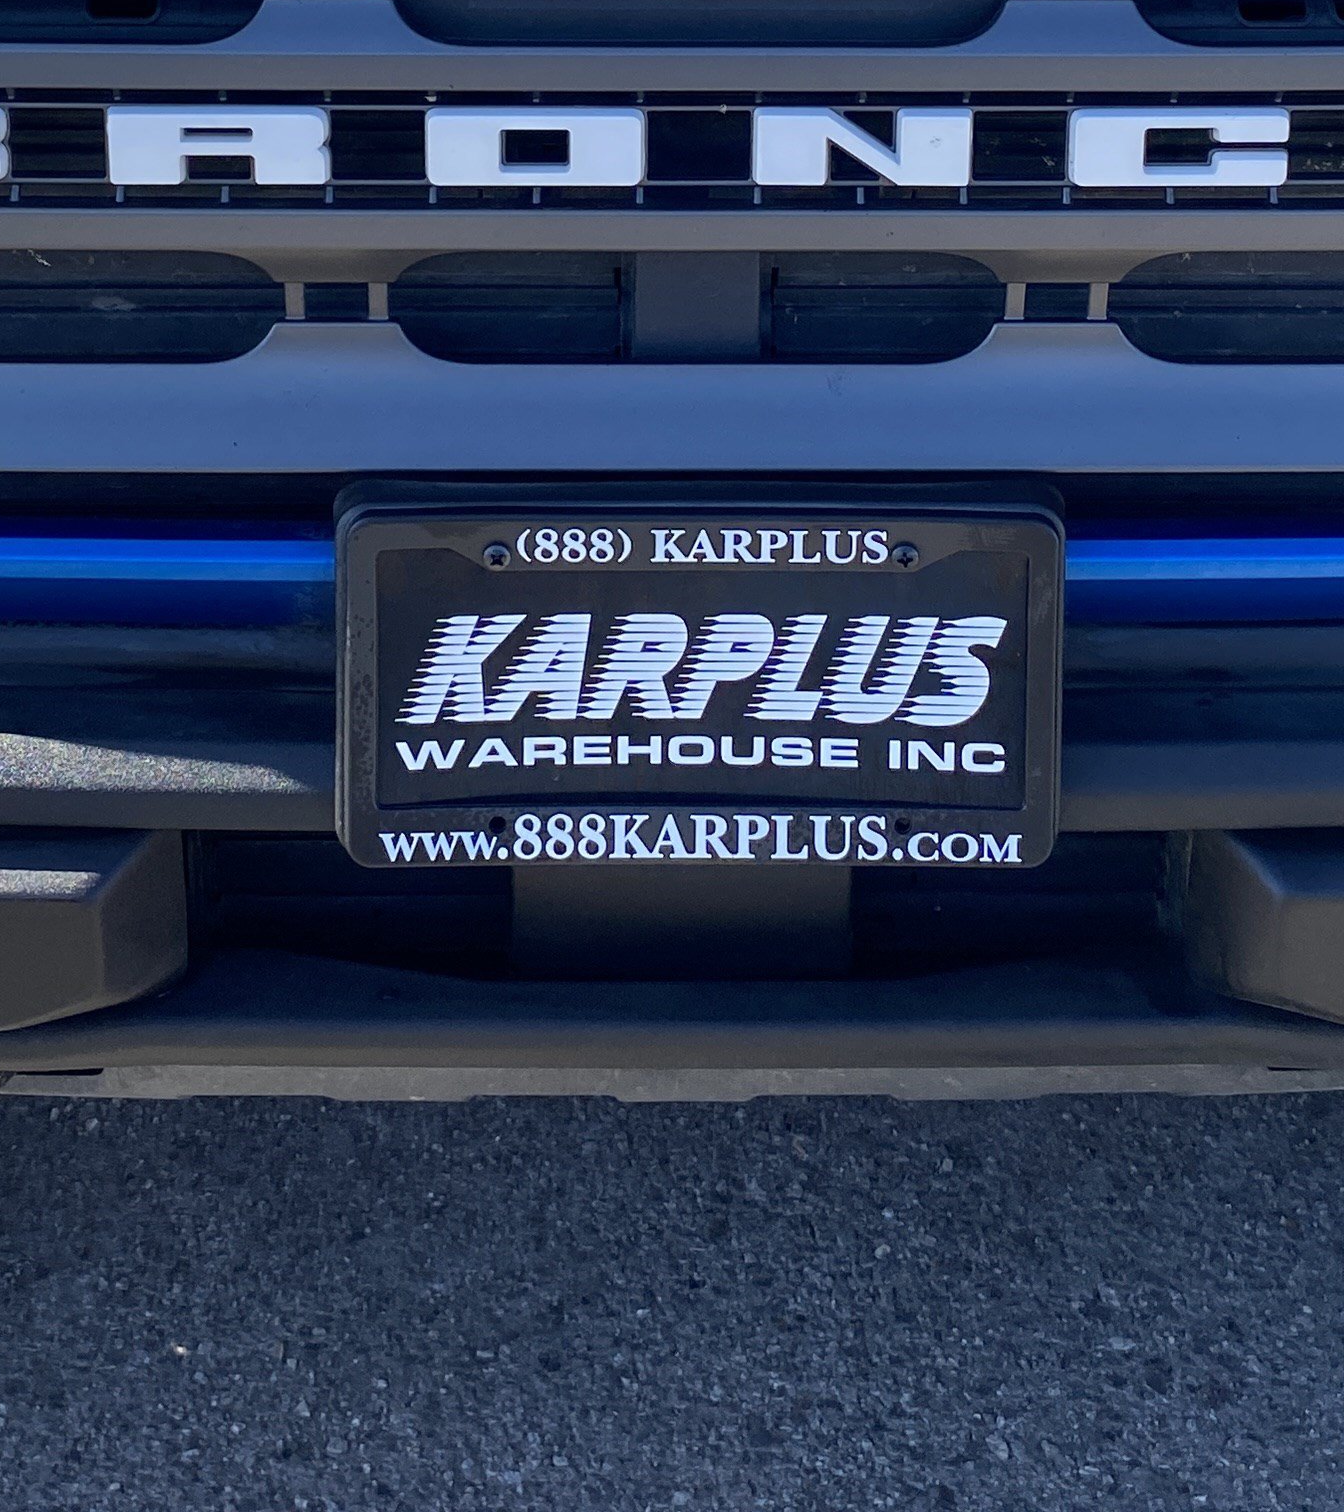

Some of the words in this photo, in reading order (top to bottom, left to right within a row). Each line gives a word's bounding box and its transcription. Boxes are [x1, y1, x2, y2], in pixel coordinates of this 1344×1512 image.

[516, 528, 633, 564] (888)
[650, 529, 889, 565] KARPLUS
[395, 613, 1009, 727] KARPLUS
[395, 735, 860, 771] WAREHOUSE
[888, 739, 1007, 773] INC
